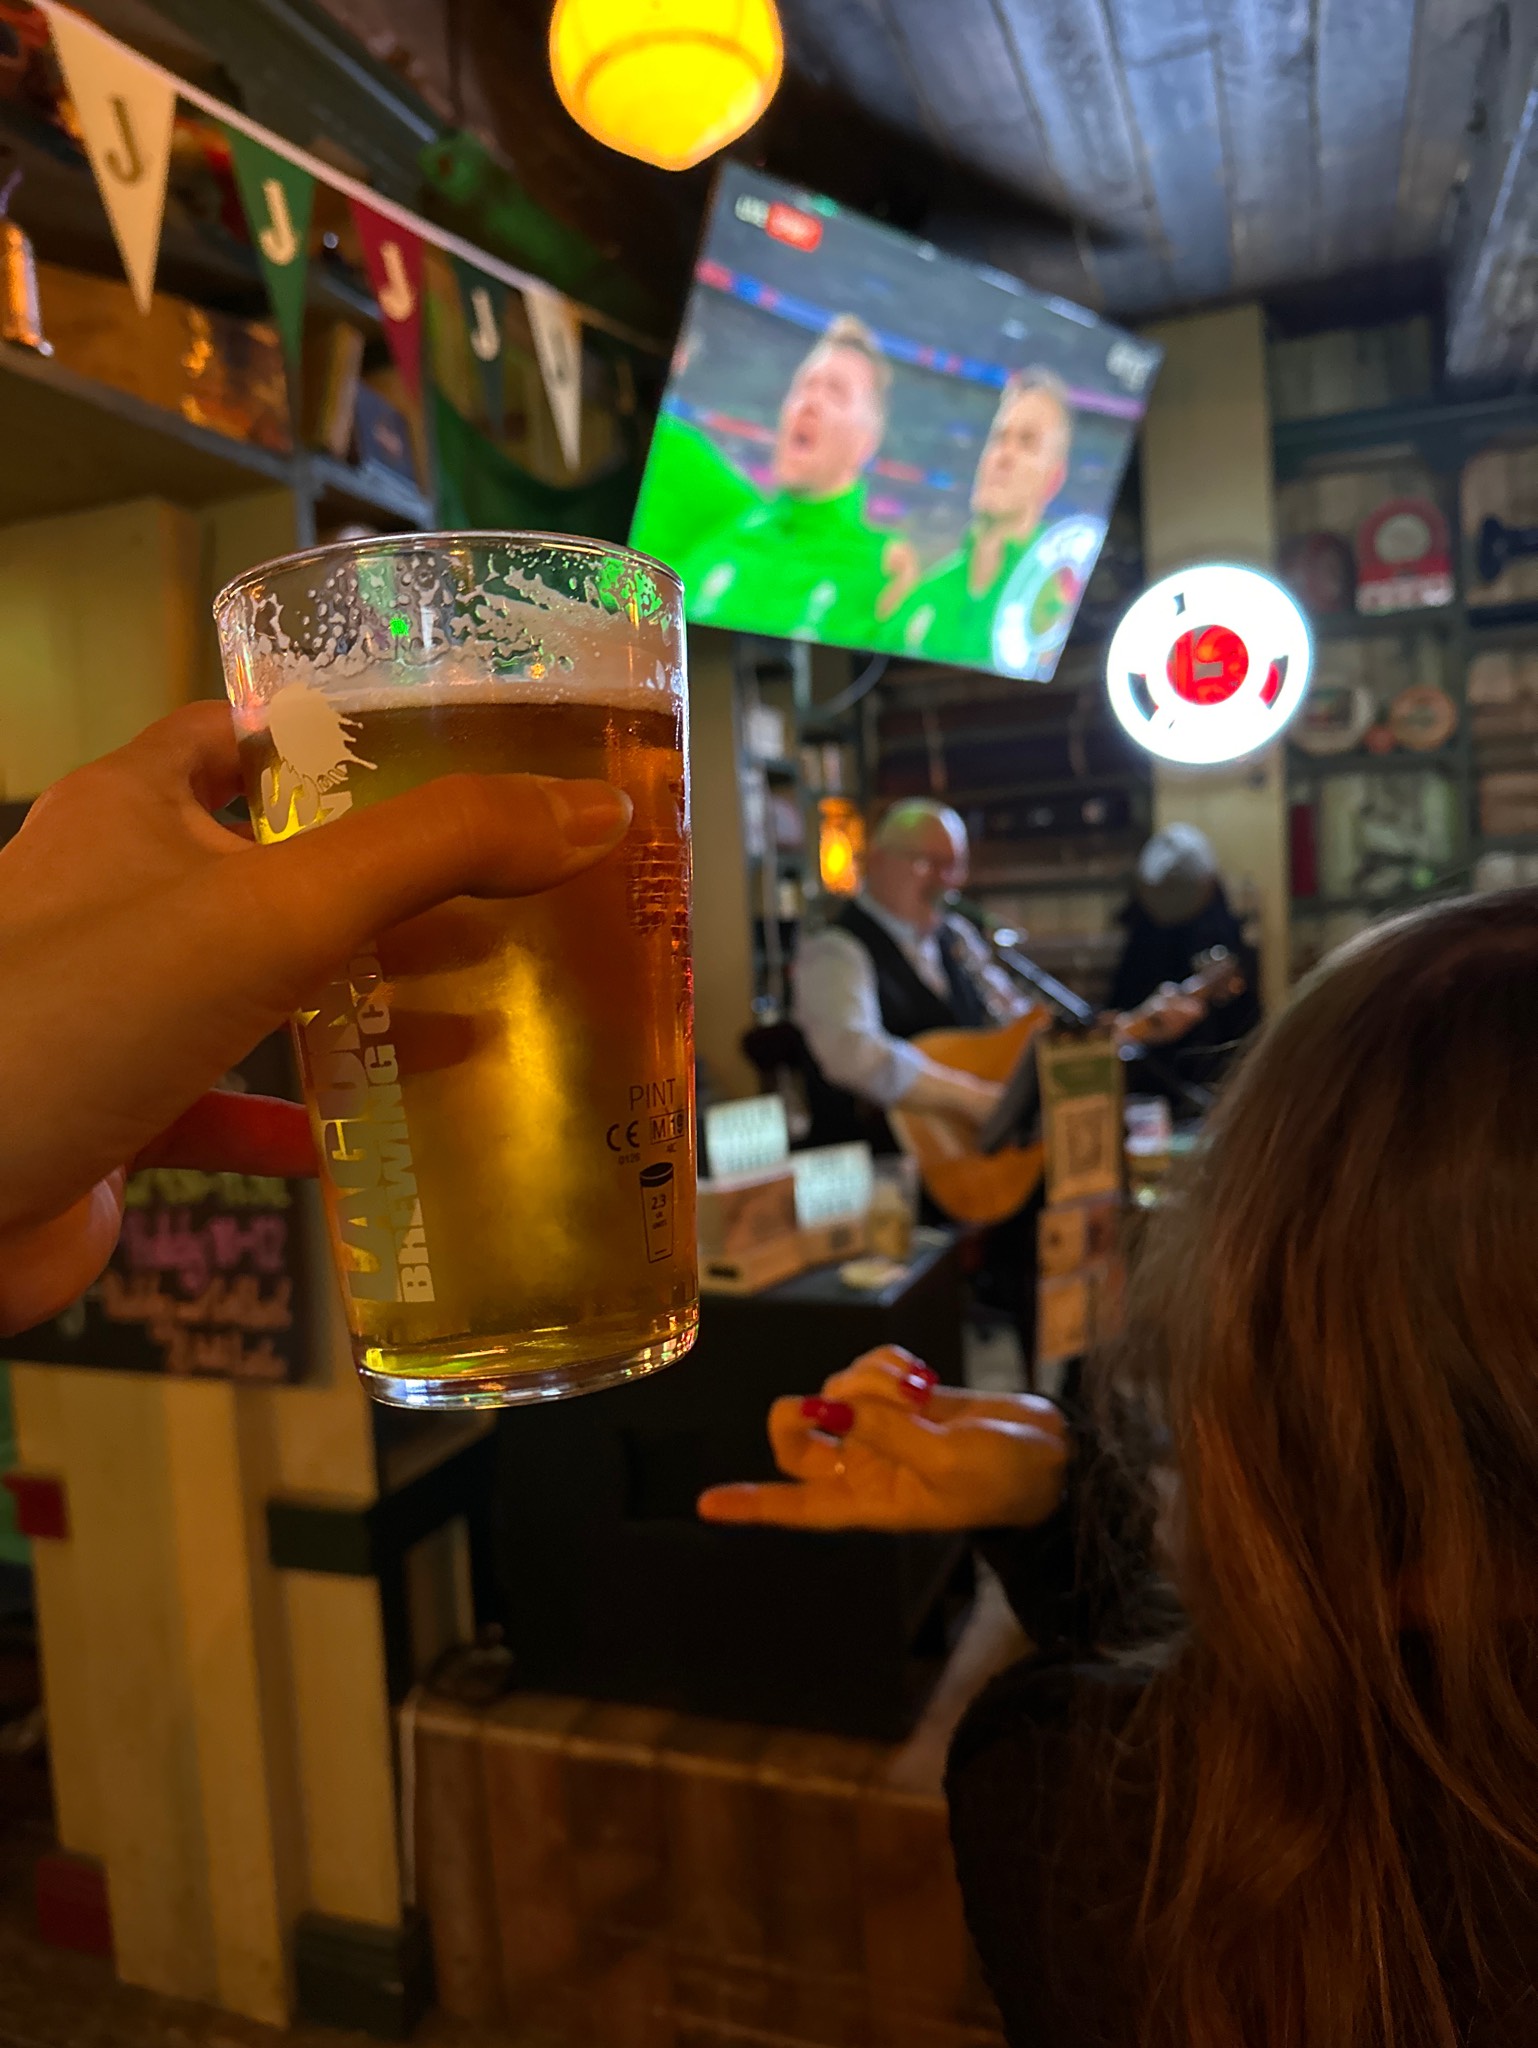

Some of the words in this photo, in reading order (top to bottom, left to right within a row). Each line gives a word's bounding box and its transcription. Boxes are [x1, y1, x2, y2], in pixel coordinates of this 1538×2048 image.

[104, 94, 142, 186] J
[258, 177, 300, 267] J
[377, 241, 415, 323] J
[469, 286, 501, 362] J
[629, 1078, 676, 1111] PINT
[363, 1043, 436, 1303] BREWING
[606, 1120, 641, 1152] CE
